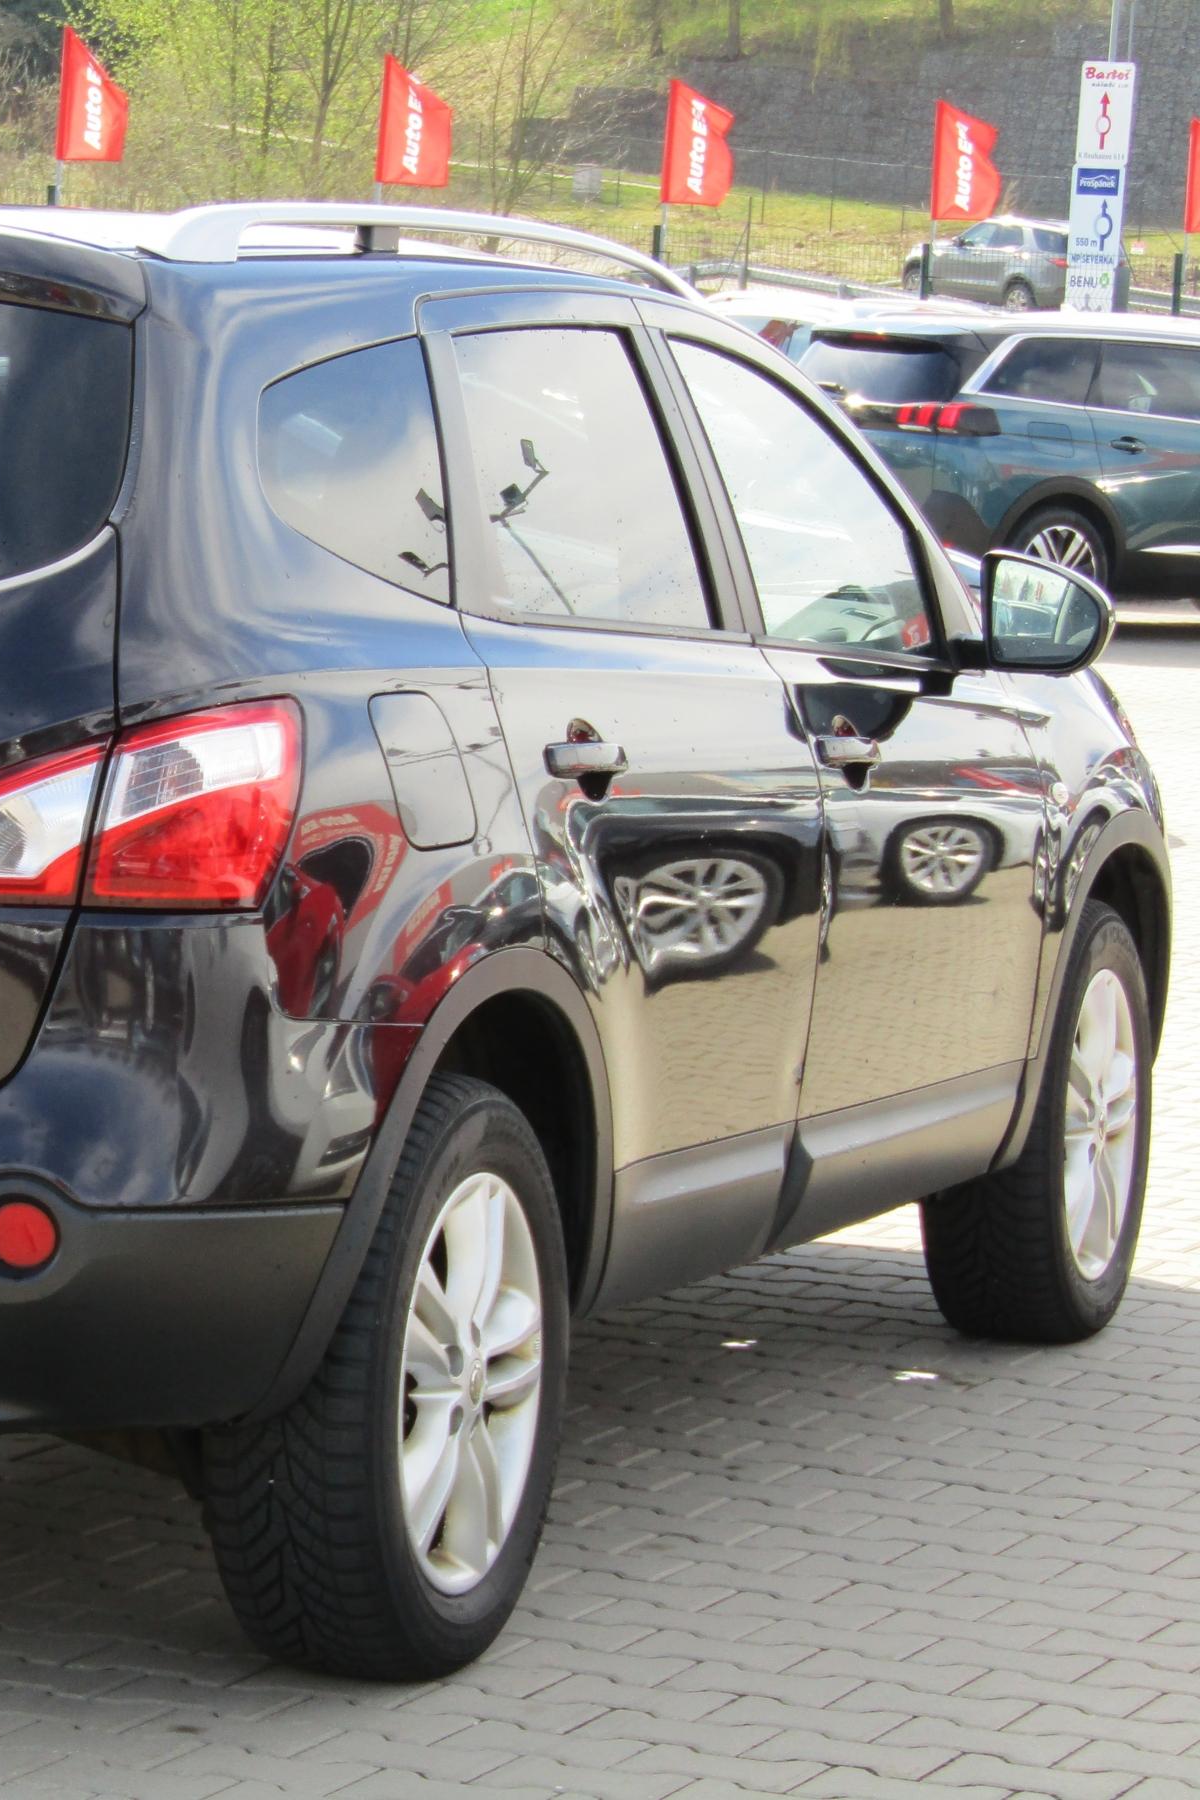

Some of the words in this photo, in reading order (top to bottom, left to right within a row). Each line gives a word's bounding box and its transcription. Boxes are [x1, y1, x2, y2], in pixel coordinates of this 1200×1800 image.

[84, 86, 103, 150] Auto
[402, 112, 423, 175] Auto
[687, 136, 707, 195] Auto
[954, 155, 973, 212] Auto
[1075, 237, 1089, 247] 550
[1070, 275, 1098, 288] BENU
